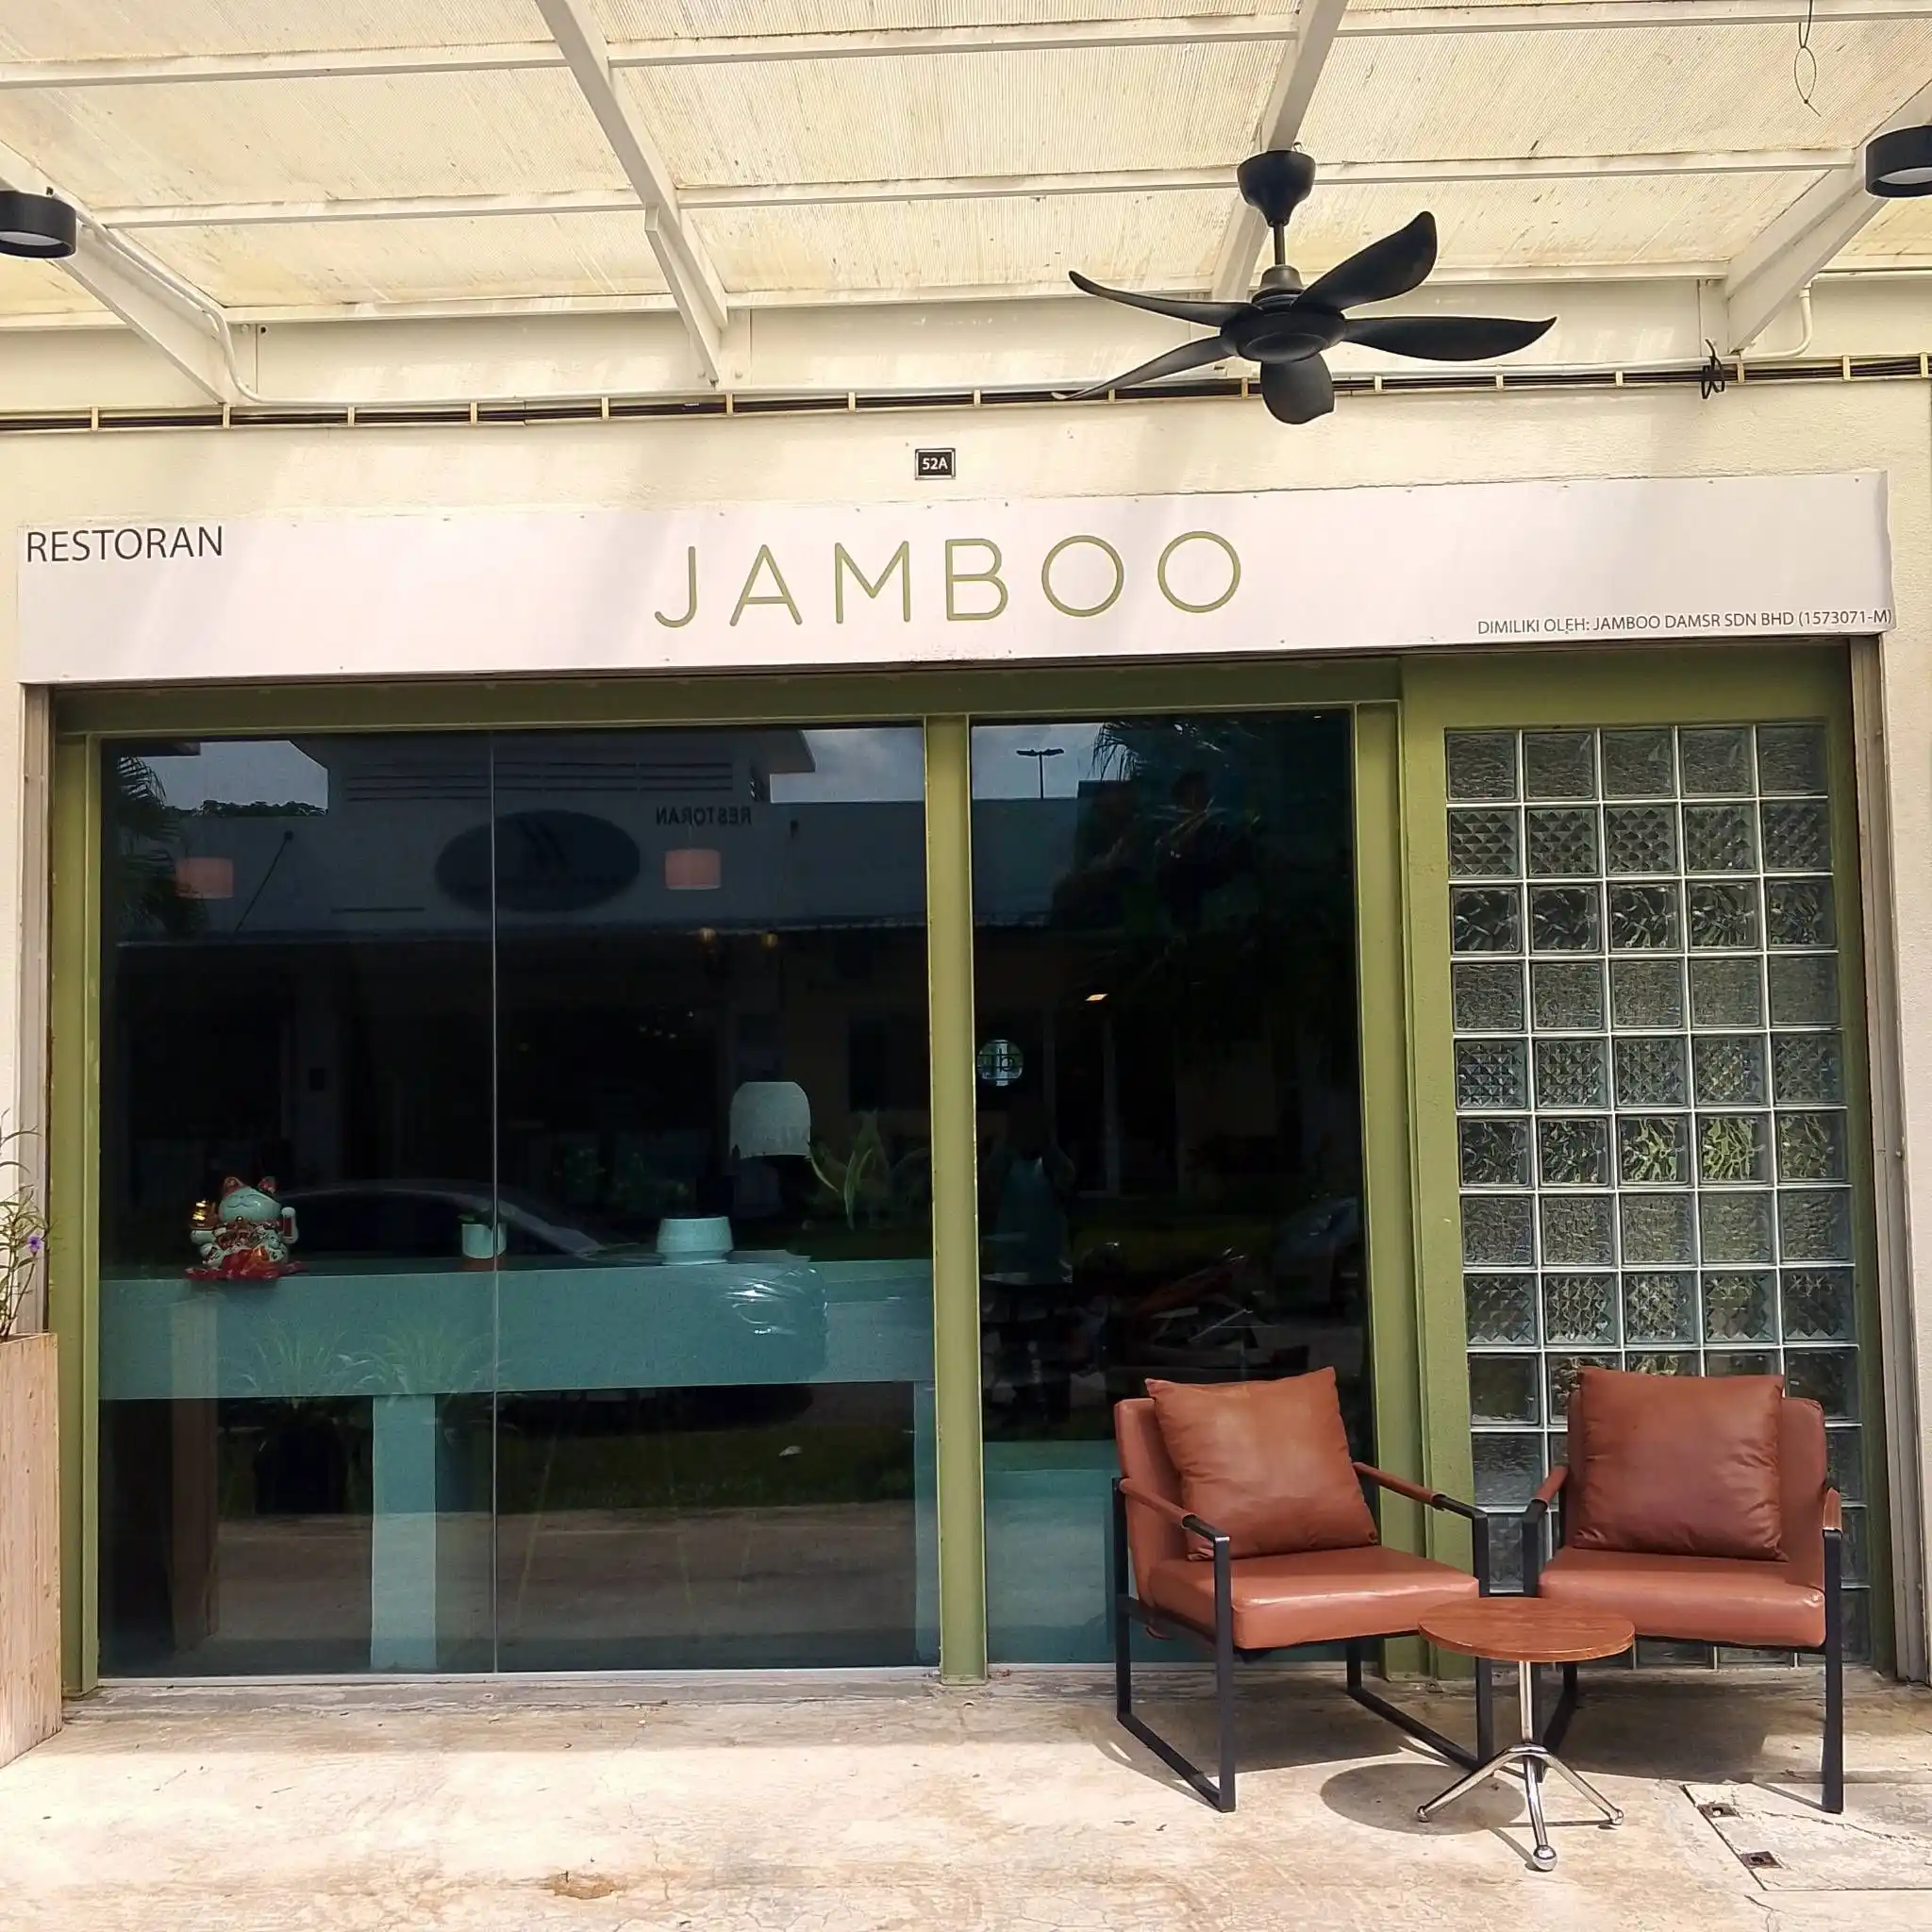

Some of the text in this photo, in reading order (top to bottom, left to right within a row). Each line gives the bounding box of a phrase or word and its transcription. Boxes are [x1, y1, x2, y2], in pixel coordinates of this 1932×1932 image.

[922, 457, 948, 471] 52A
[26, 525, 223, 562] RESTORAN
[654, 530, 1241, 628] JAMBOO
[1477, 608, 1892, 635] DIMILIKI OLEH: JAMBOO DAMSR SDN BHD (1573071-M)
